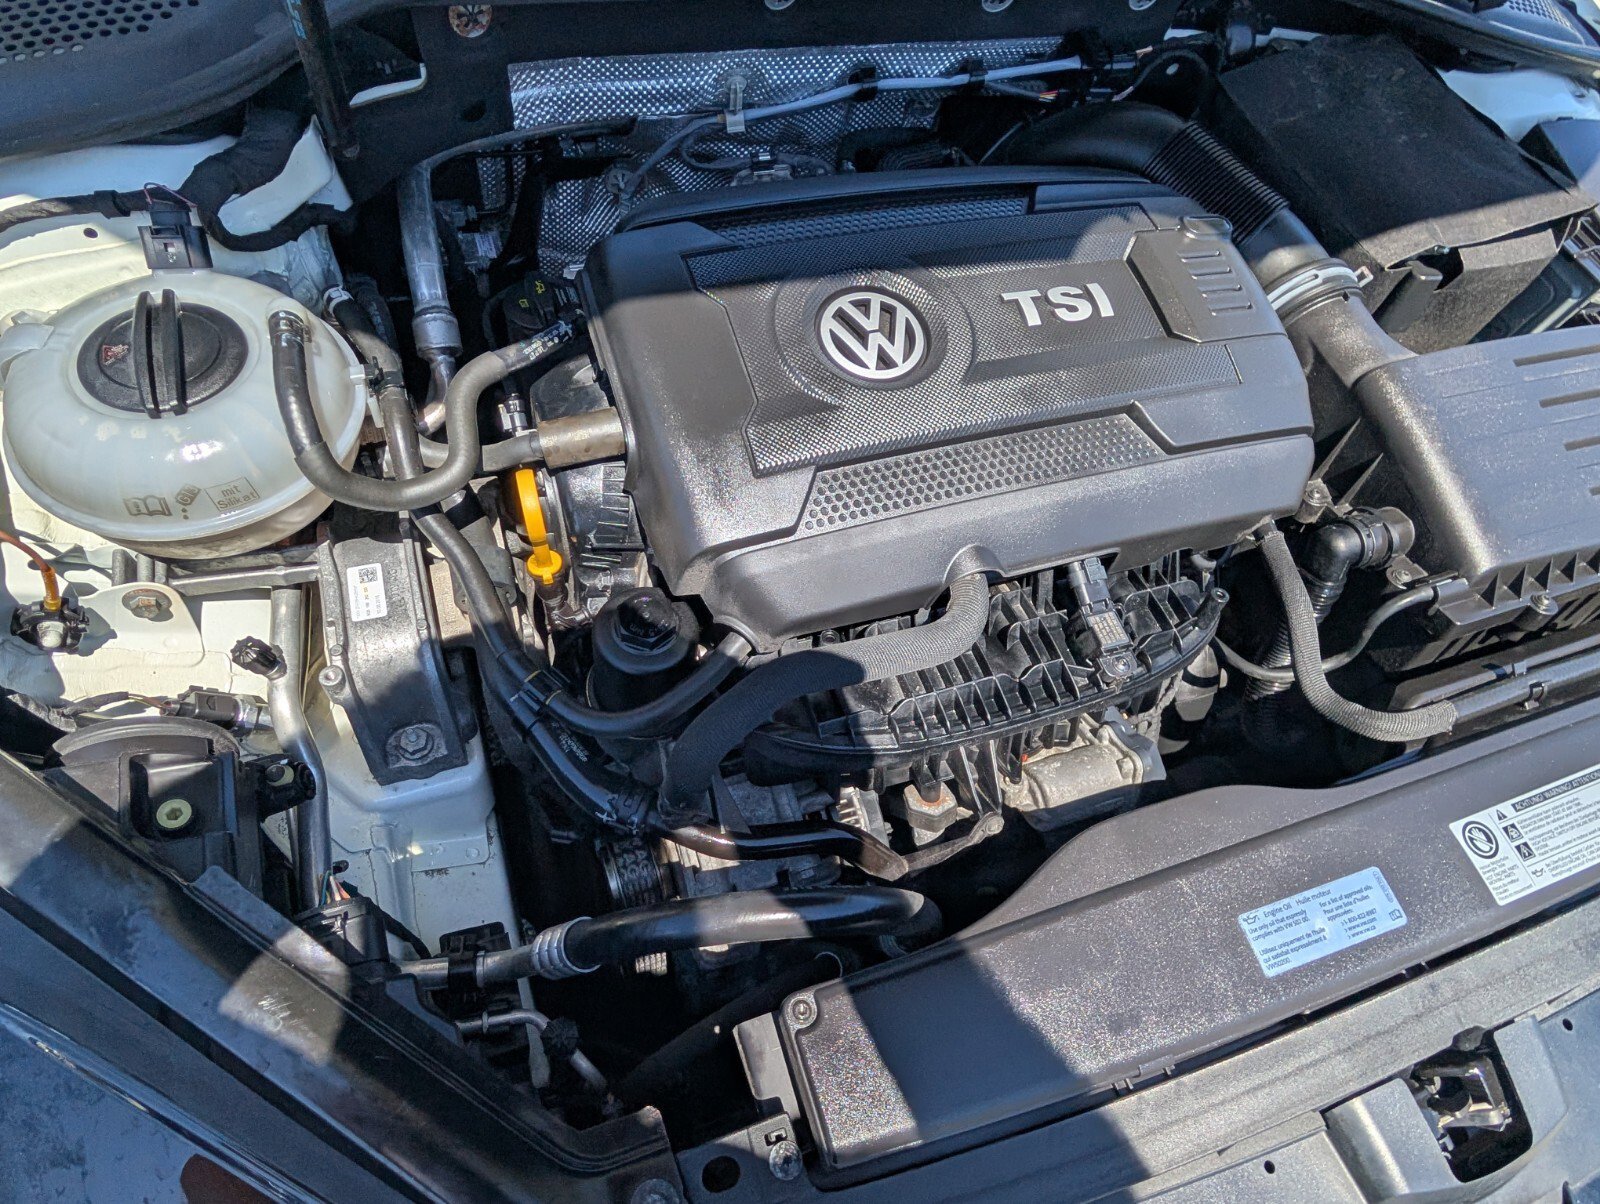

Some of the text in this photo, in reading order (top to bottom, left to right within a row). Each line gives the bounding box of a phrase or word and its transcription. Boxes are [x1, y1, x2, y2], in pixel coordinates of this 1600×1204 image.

[1001, 282, 1115, 327] TSI
[217, 491, 257, 509] Silikat
[221, 484, 242, 498] mit
[1263, 889, 1331, 918] Engine Oil Huile moteur
[1258, 923, 1269, 931] only
[1268, 919, 1276, 927] oil
